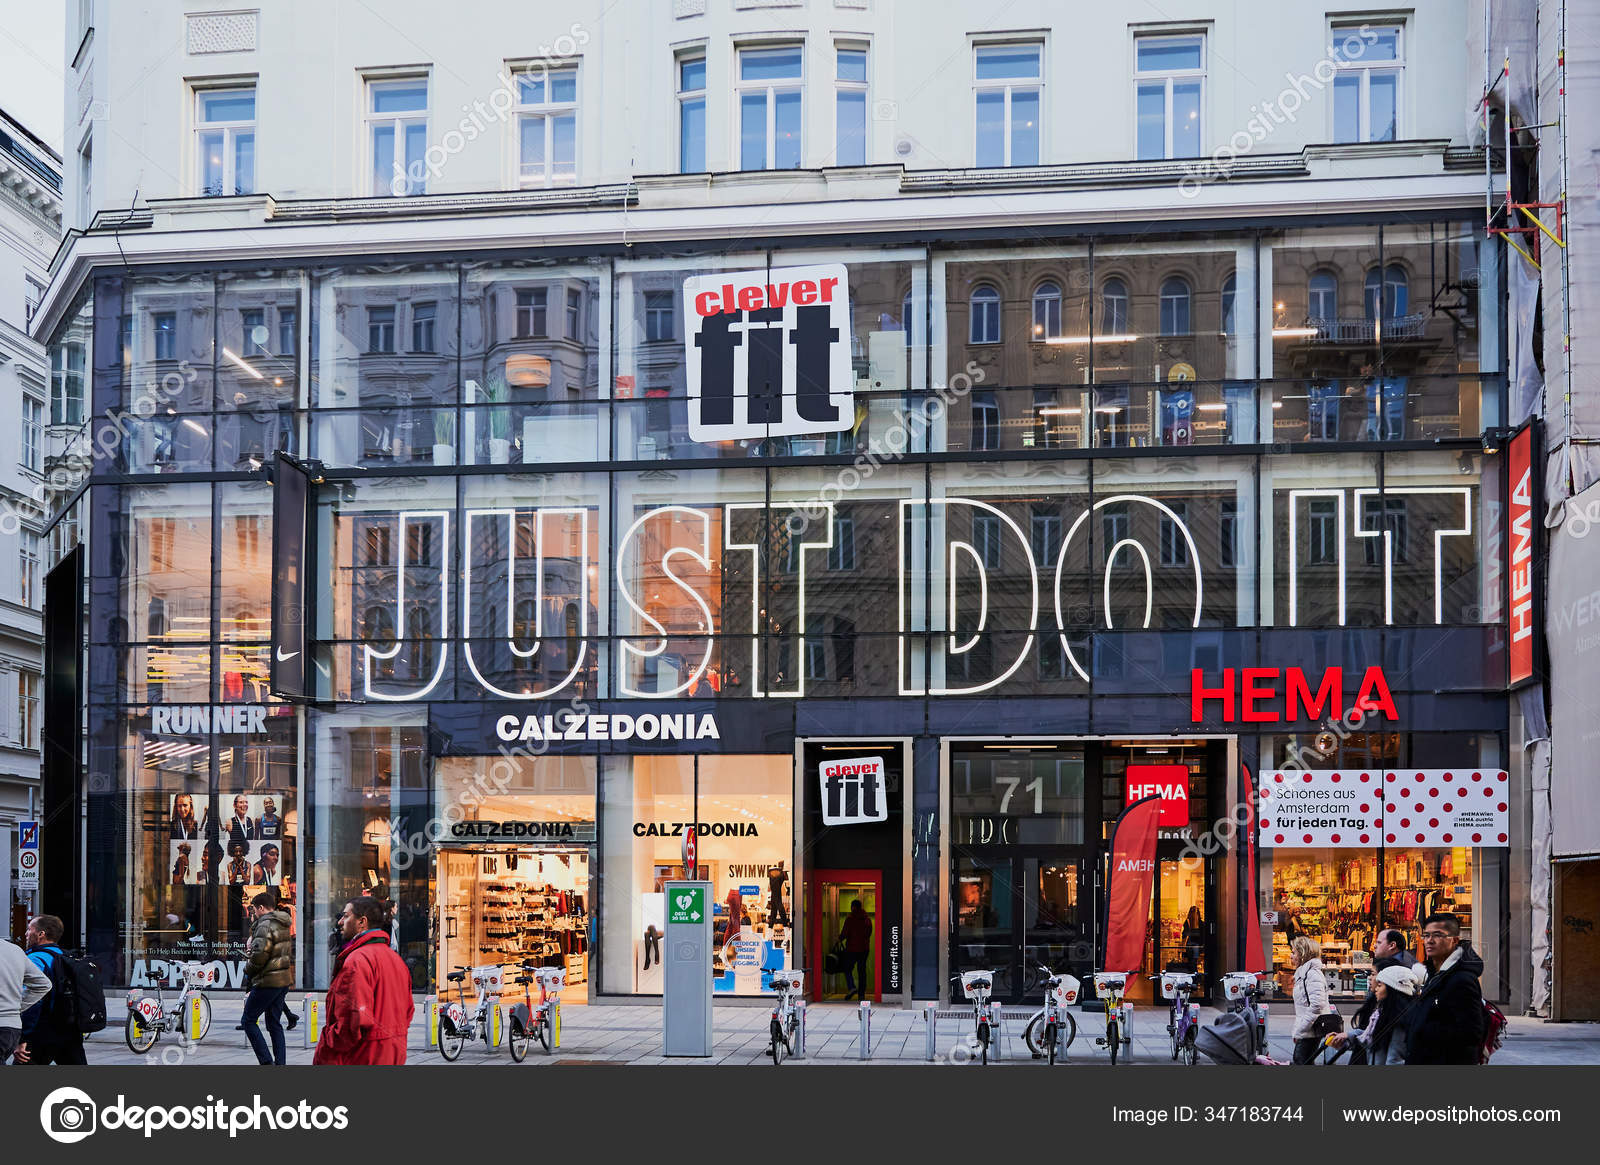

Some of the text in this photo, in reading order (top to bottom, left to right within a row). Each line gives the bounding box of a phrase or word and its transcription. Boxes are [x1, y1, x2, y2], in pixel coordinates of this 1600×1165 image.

[695, 277, 838, 317] clever
[695, 305, 839, 425] fit
[1512, 465, 1532, 643] HEMA
[364, 487, 1471, 700] JUST DO IT
[1191, 666, 1399, 723] HEMA
[152, 706, 267, 734] RUNNER
[496, 714, 720, 742] CALZEDONIA
[825, 763, 880, 777] clever
[825, 773, 880, 817] fit
[996, 776, 1043, 814] 71
[1129, 784, 1187, 800] HEMA
[1333, 789, 1355, 800] aus
[1276, 803, 1350, 814] Amsterdam
[451, 822, 573, 837] CALZEDONIA
[1276, 817, 1368, 830] für jeden Tag.
[21, 870, 36, 878] Zone
[24, 855, 33, 865] 30
[891, 926, 899, 988] clever-fit.com
